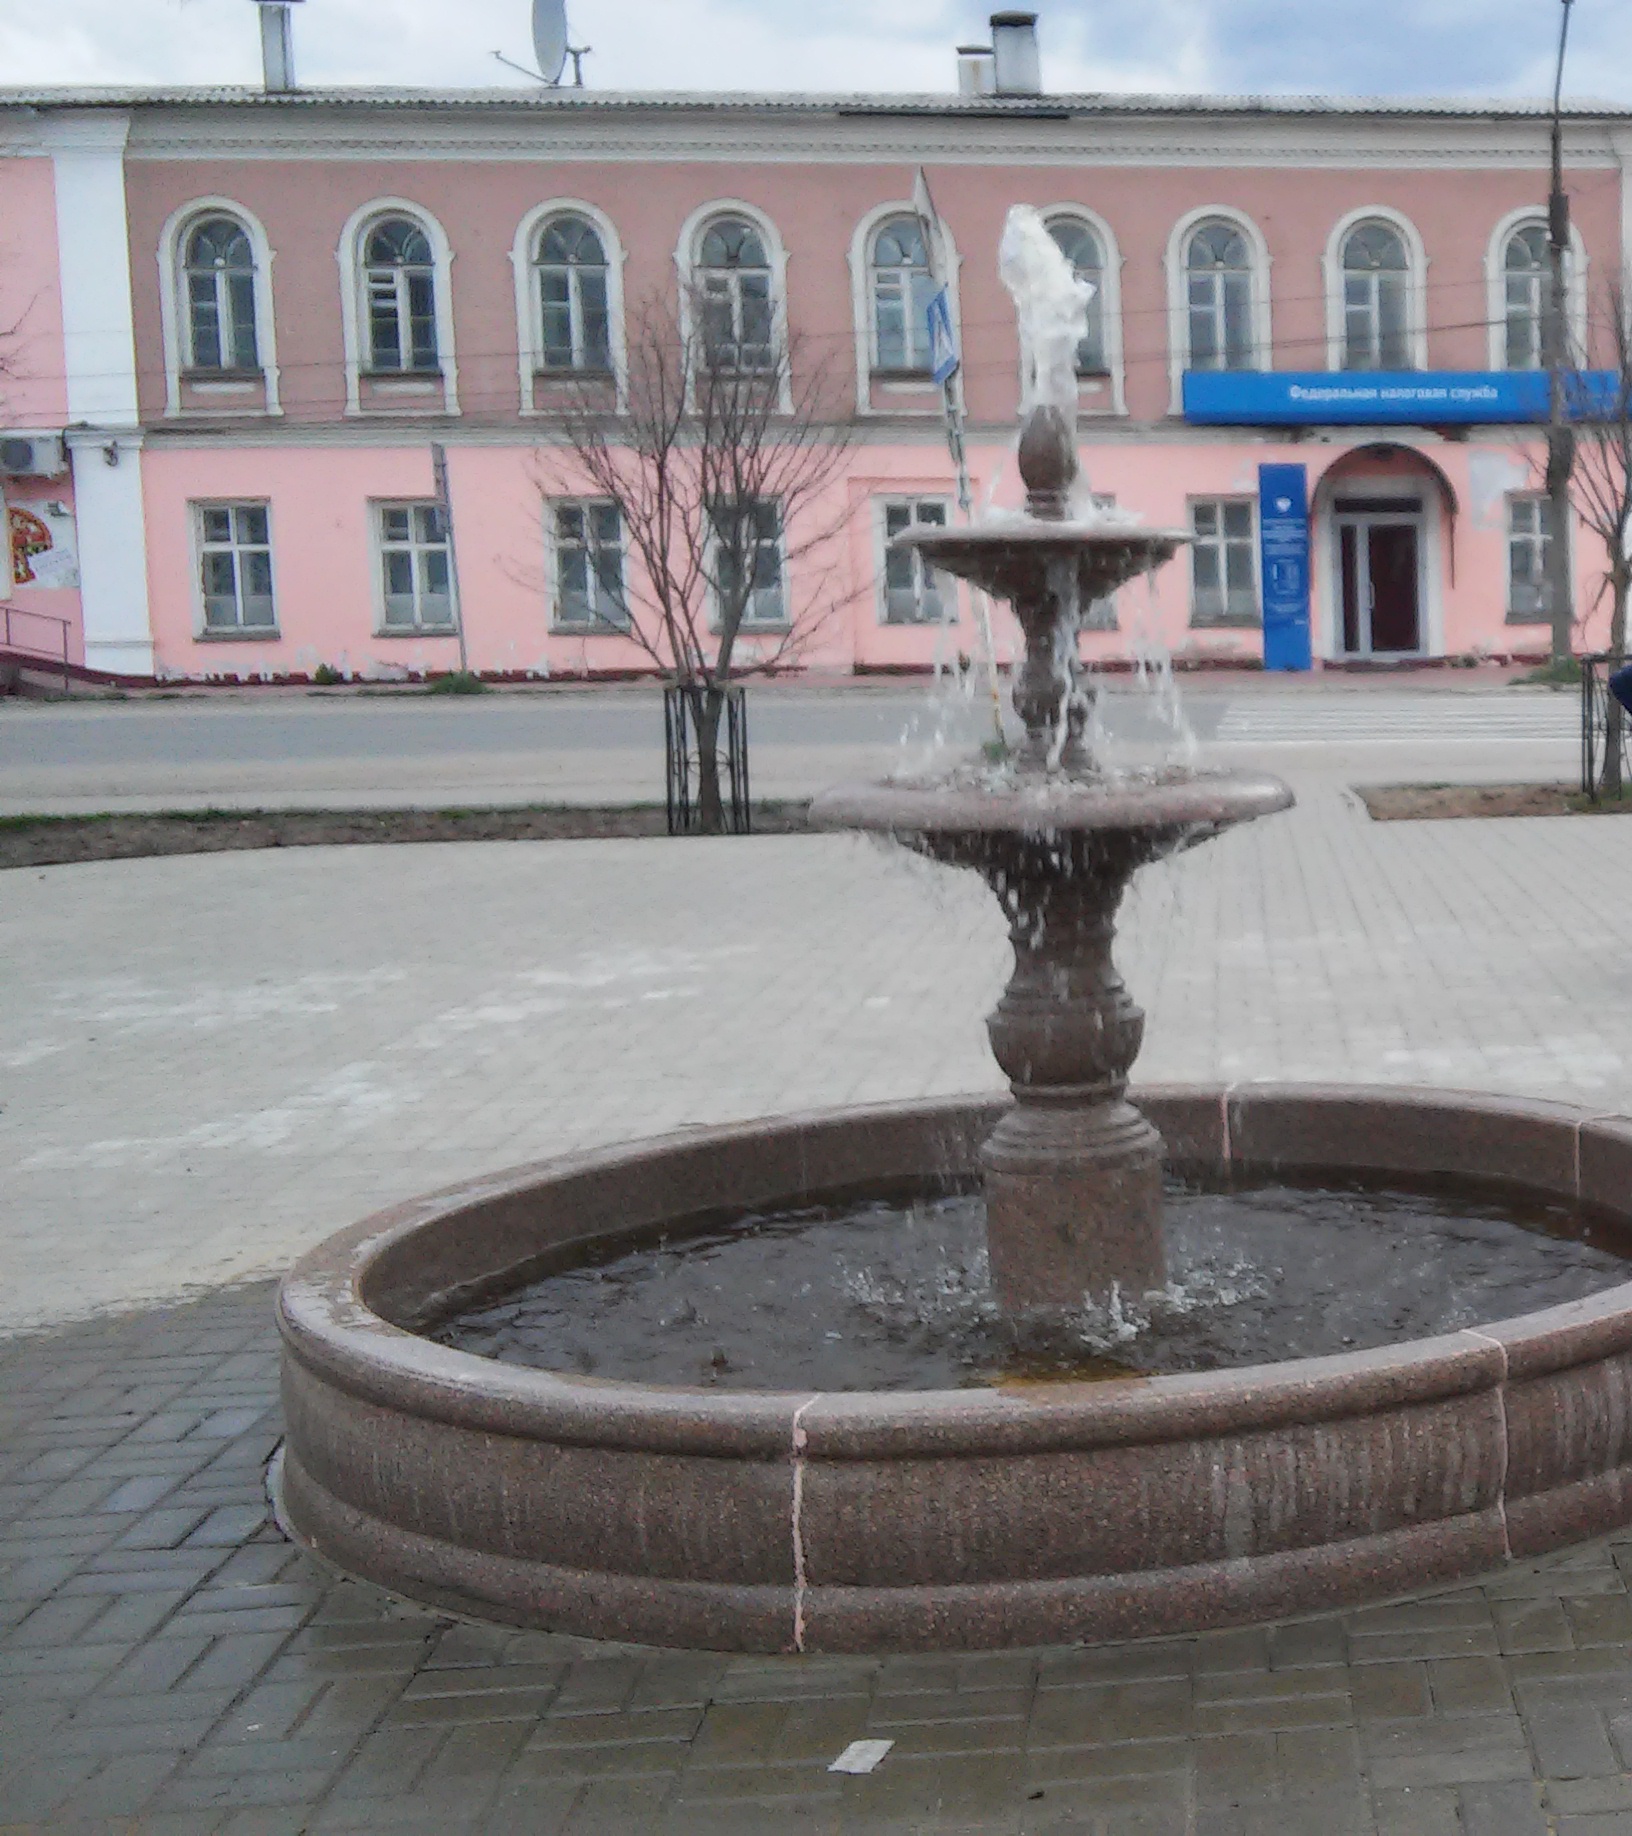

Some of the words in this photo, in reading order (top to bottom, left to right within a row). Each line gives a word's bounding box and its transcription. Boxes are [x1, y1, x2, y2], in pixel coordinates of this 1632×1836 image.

[1289, 384, 1377, 401] Федеральная
[1380, 387, 1447, 399] налоговая
[1450, 385, 1498, 401] служба
